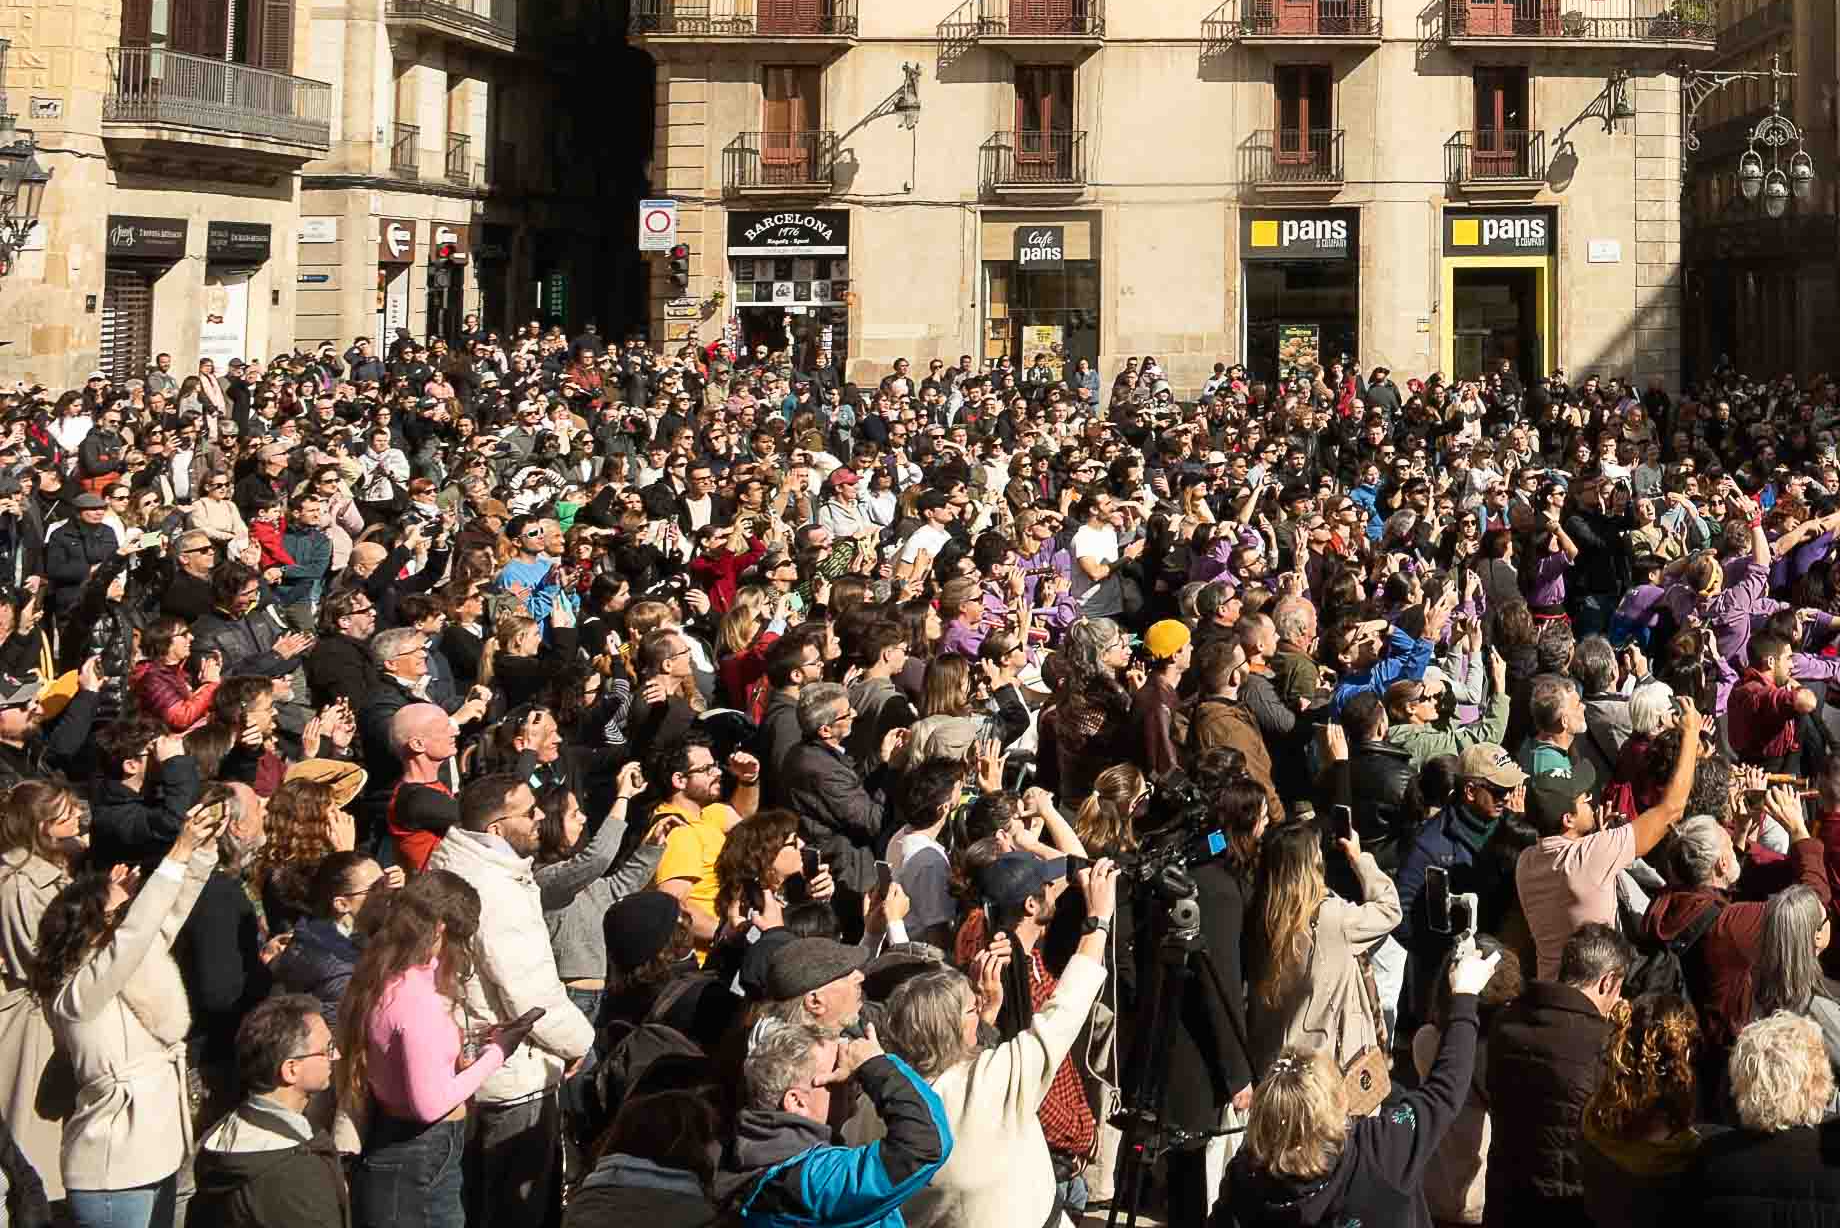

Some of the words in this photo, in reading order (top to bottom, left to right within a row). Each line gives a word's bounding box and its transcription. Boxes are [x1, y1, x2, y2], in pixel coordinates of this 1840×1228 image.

[744, 213, 833, 241] BARCELONA
[1282, 220, 1347, 246] pans
[1482, 219, 1545, 245] pans
[1020, 247, 1062, 264] pans
